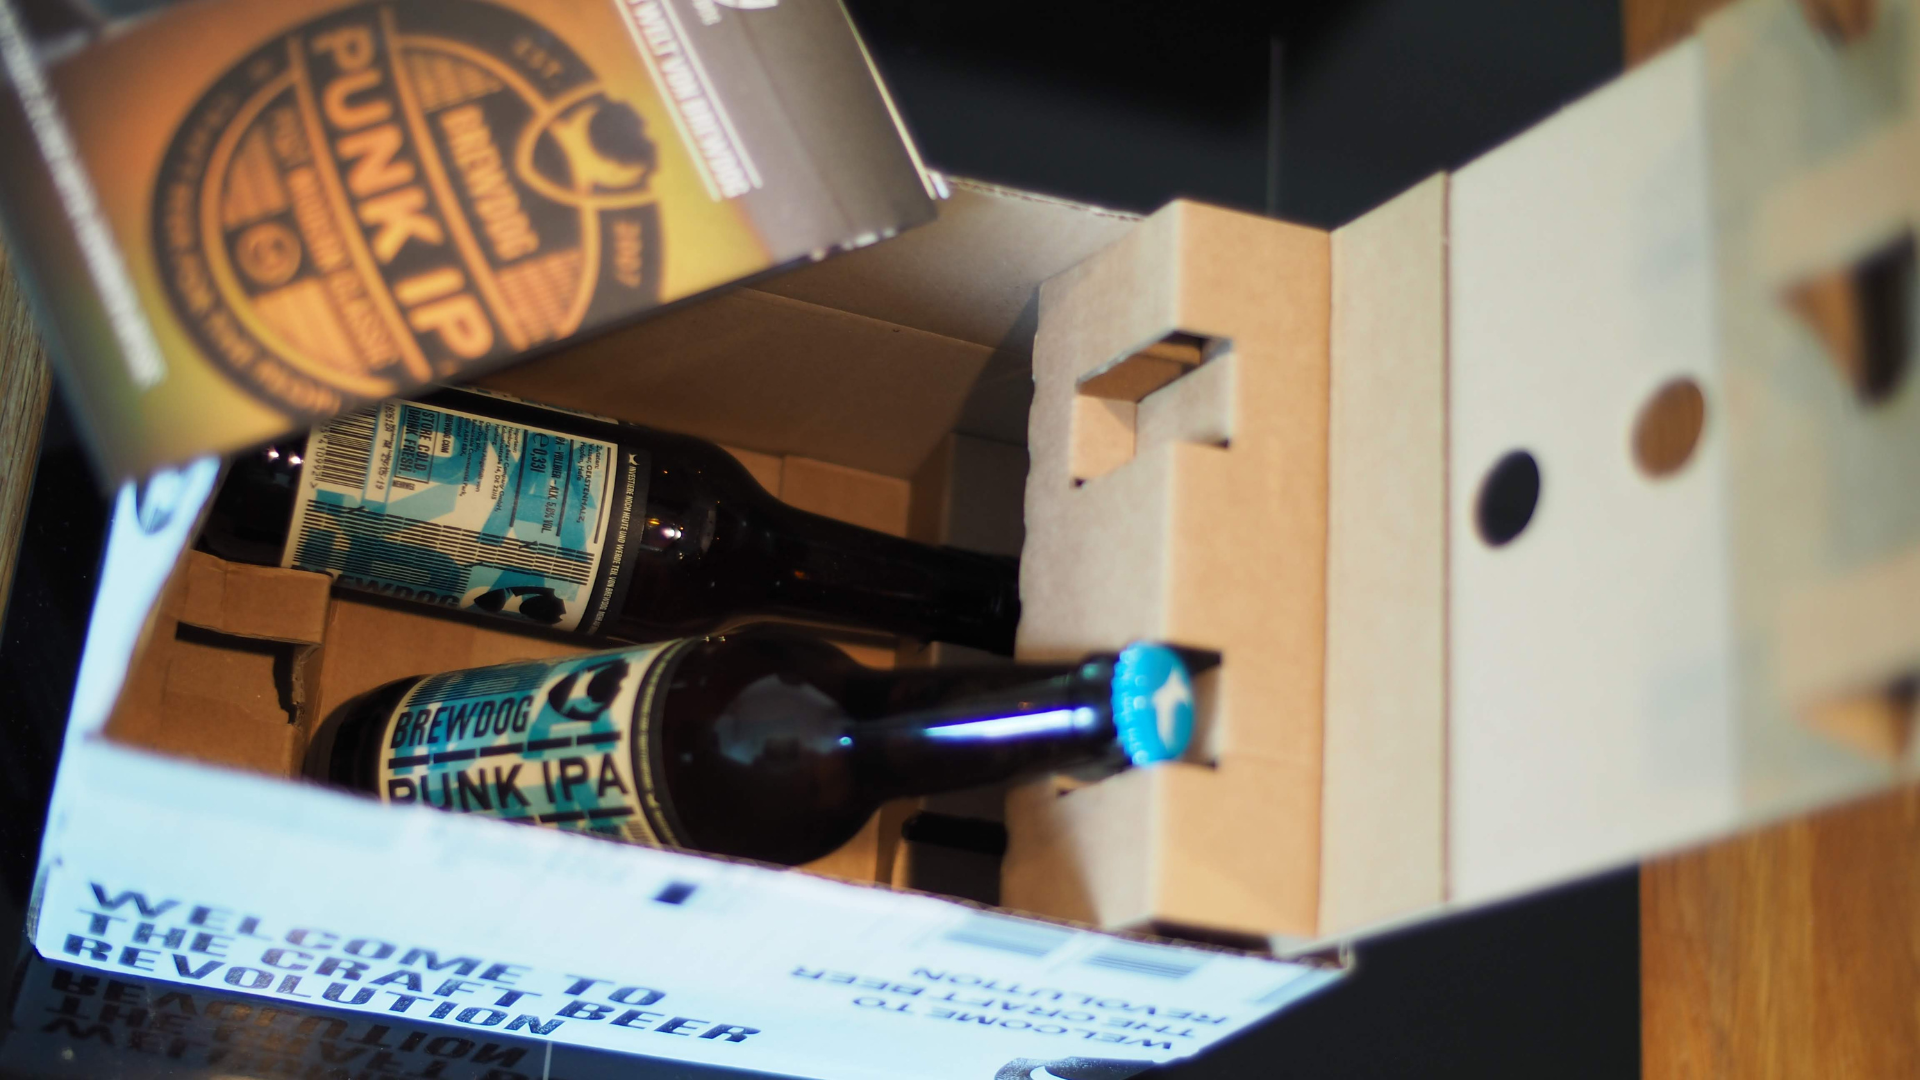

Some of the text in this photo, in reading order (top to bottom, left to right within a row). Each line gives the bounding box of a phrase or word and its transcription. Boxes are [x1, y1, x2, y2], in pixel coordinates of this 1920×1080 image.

[440, 104, 540, 262] BREWDOG
[313, 25, 495, 378] PUNK IP
[404, 408, 421, 435] DRINK
[397, 438, 416, 475] FRESH.
[412, 411, 435, 474] STORE COLD.
[494, 474, 500, 483] DE
[500, 461, 510, 489] Company
[552, 450, 564, 478] VOLLBIER
[623, 495, 633, 511] NOCH
[620, 511, 630, 530] HEUTE
[617, 530, 626, 543] UND
[613, 543, 623, 564] WERDE
[607, 576, 616, 588] VON
[610, 564, 619, 576] TEIL
[391, 695, 535, 749] BREWDOG
[388, 752, 629, 813] PUNK IPA
[90, 881, 667, 1006] WELCOME TO
[63, 934, 566, 1035] REVOLUTION
[77, 909, 762, 1043] THE CRAFT BEER
[790, 965, 926, 996] BEER
[911, 967, 1230, 1025] REVOLUTION
[851, 996, 1173, 1051] WELCOME TO
[1105, 1014, 1196, 1038] THE
